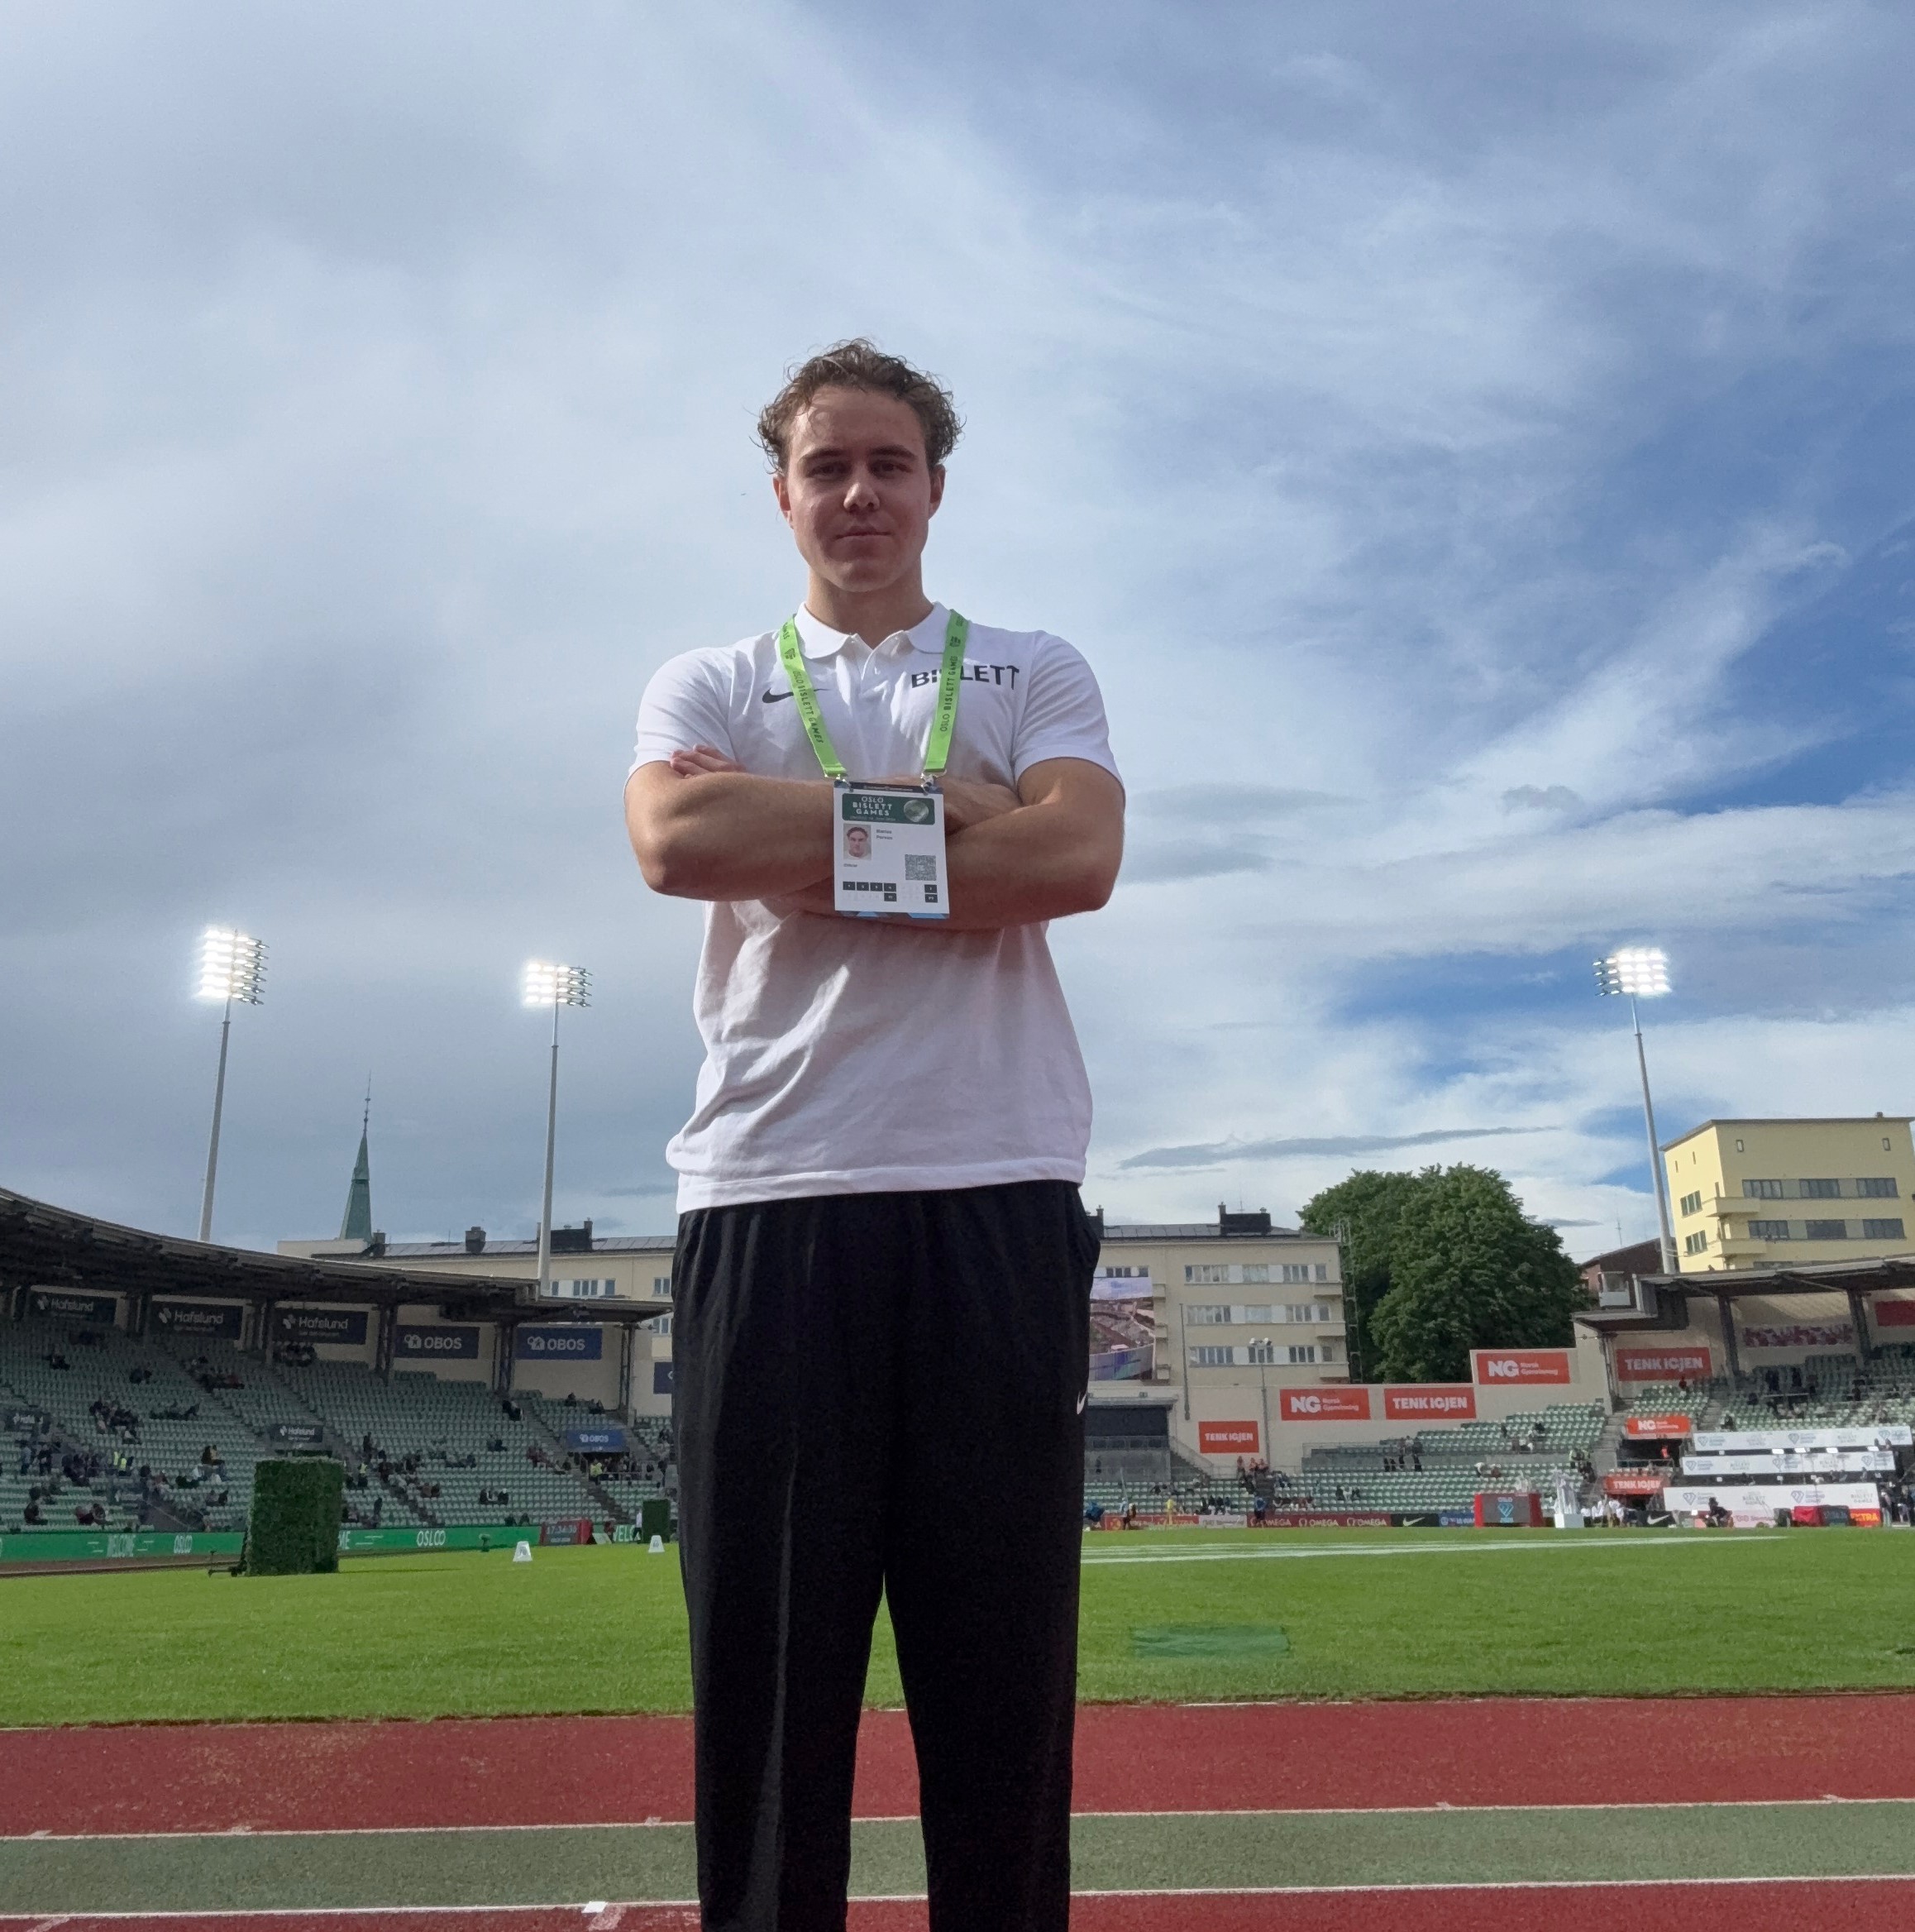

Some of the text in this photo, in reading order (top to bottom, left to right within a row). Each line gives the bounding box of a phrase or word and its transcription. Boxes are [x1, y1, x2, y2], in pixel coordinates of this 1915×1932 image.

[911, 664, 1020, 691] BILETT
[943, 677, 955, 711] BISLETT
[939, 714, 951, 732] OSLO
[852, 801, 893, 811] BISLETT
[174, 1311, 224, 1324] Hafslund
[298, 1316, 349, 1330] Hafslund
[423, 1336, 462, 1350] OBOS
[547, 1338, 586, 1351] OBOS
[1488, 1361, 1520, 1377] NG
[1624, 1356, 1703, 1373] TENK IGJEN
[1291, 1395, 1321, 1413] NG
[1392, 1397, 1468, 1412] TENK IGJEN
[589, 1434, 609, 1443] OBOS
[1205, 1432, 1254, 1443] TENK IGJEN
[1310, 1518, 1340, 1527] OMEGA
[1358, 1518, 1387, 1526] OMEGA
